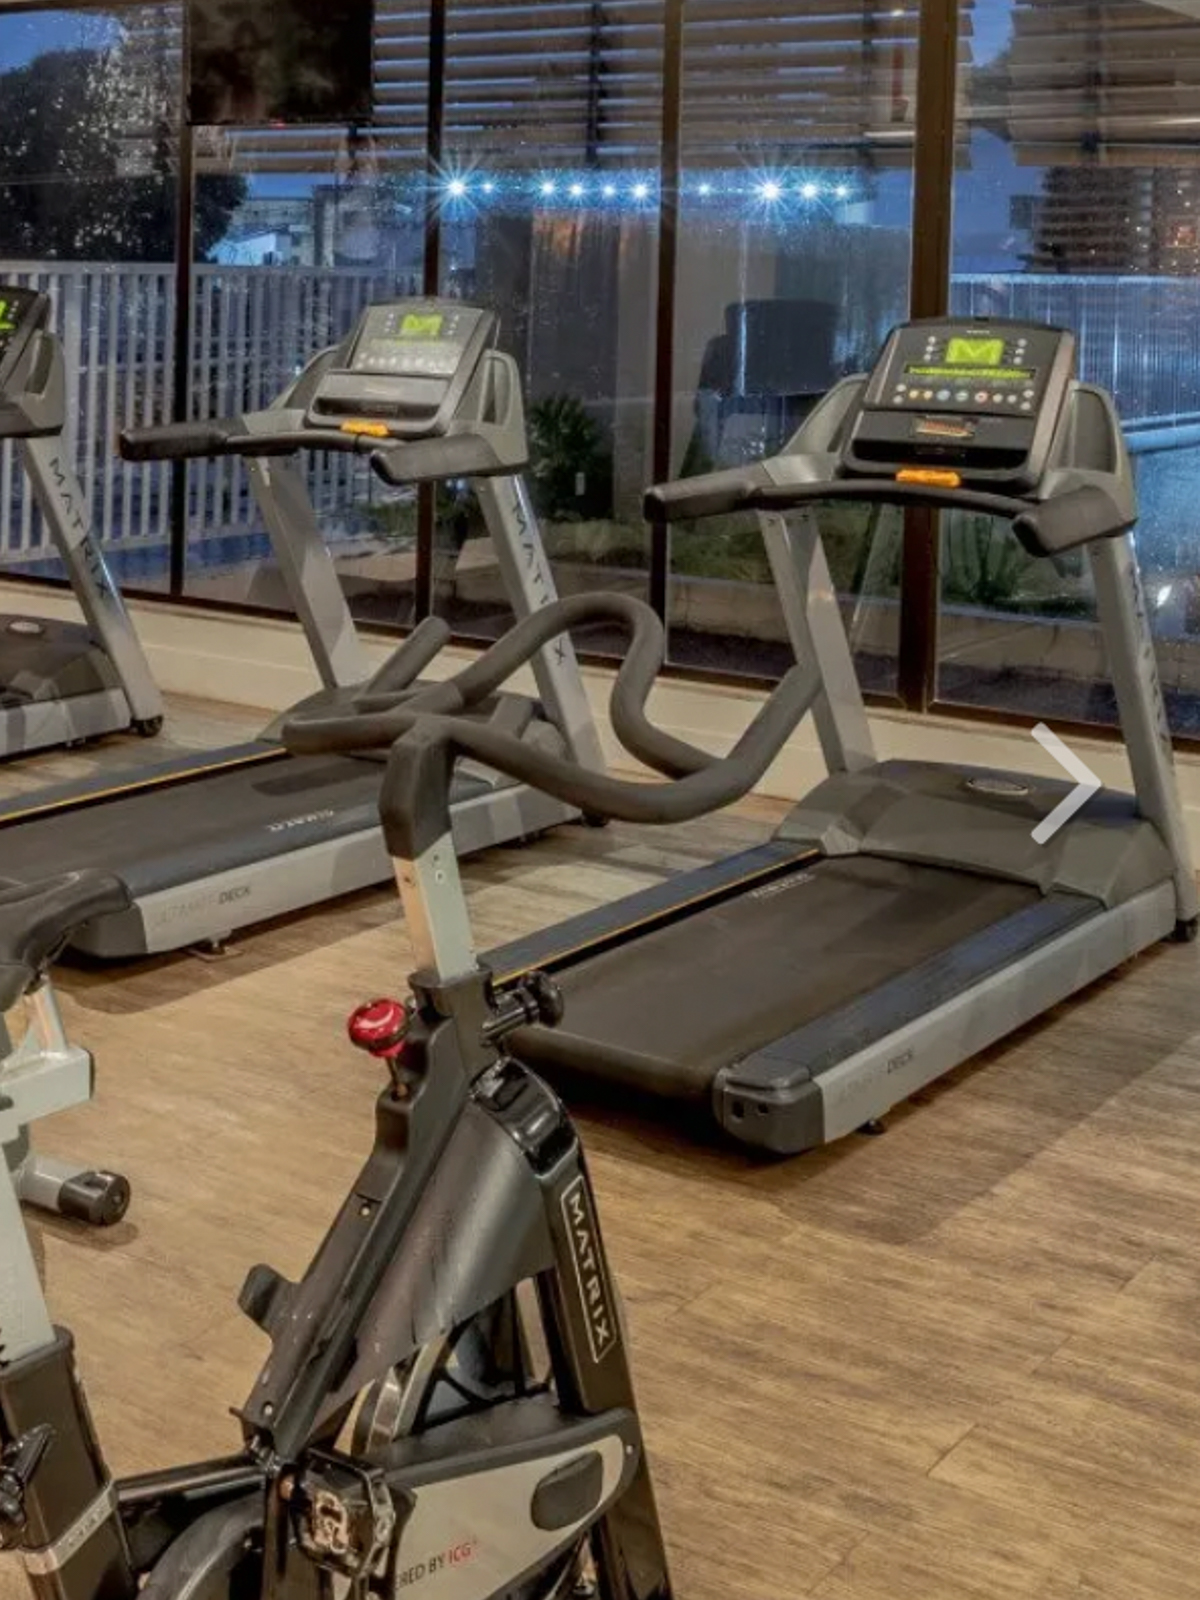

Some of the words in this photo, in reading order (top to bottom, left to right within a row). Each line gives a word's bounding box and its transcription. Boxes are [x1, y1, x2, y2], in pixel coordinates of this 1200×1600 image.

[48, 456, 108, 597] MATRIX
[512, 488, 566, 666] MATX
[570, 1192, 610, 1346] MATRIX
